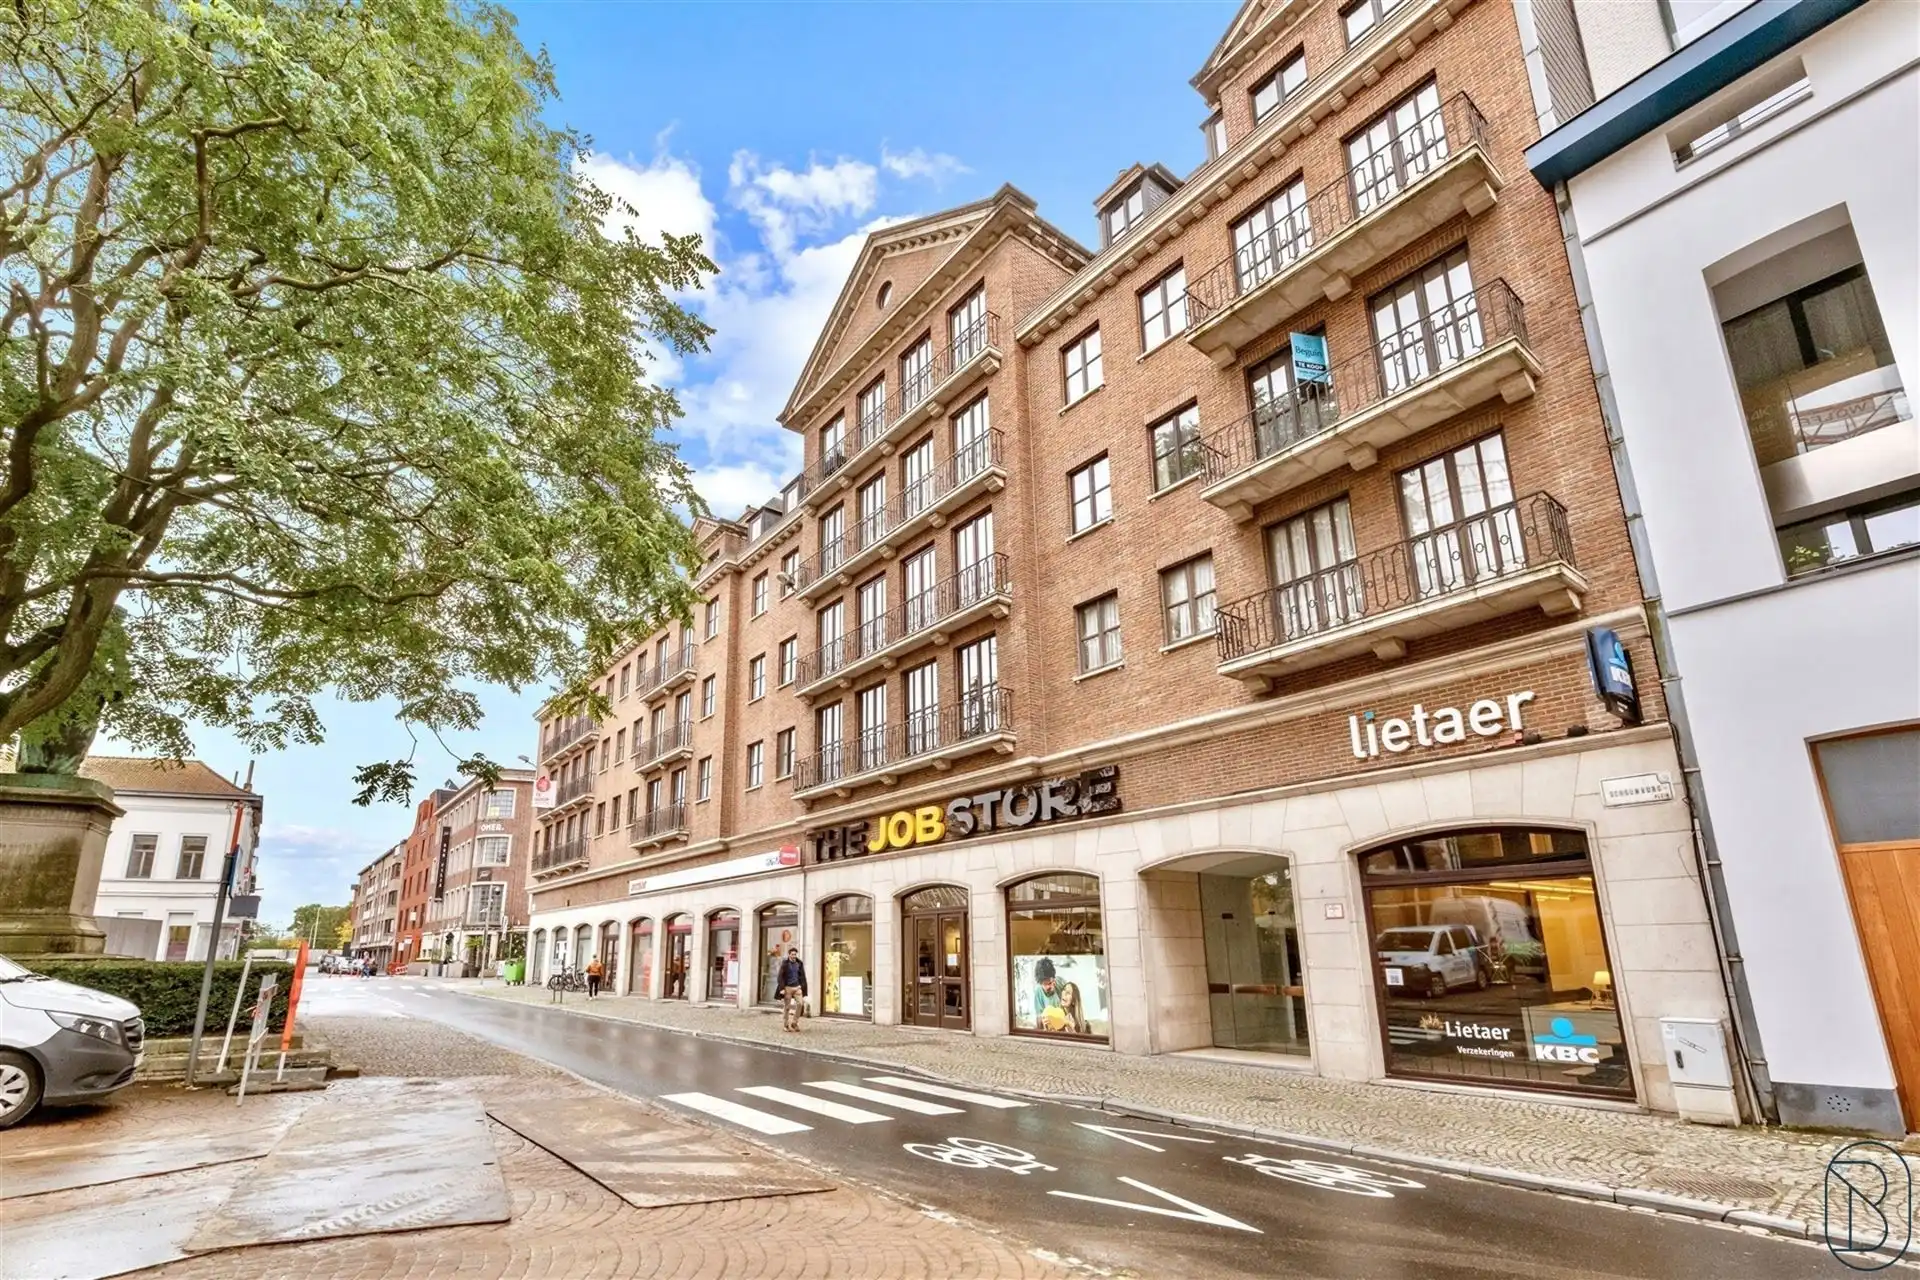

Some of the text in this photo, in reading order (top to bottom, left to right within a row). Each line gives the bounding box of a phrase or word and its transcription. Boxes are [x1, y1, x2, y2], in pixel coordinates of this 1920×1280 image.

[1295, 346, 1324, 359] Beguin
[1349, 690, 1536, 758] lietaer
[807, 765, 1122, 863] THE JOB STORE
[1444, 1020, 1511, 1041] Lietaer
[1456, 1045, 1515, 1058] Verzekeringen
[1535, 1044, 1600, 1064] KBC
